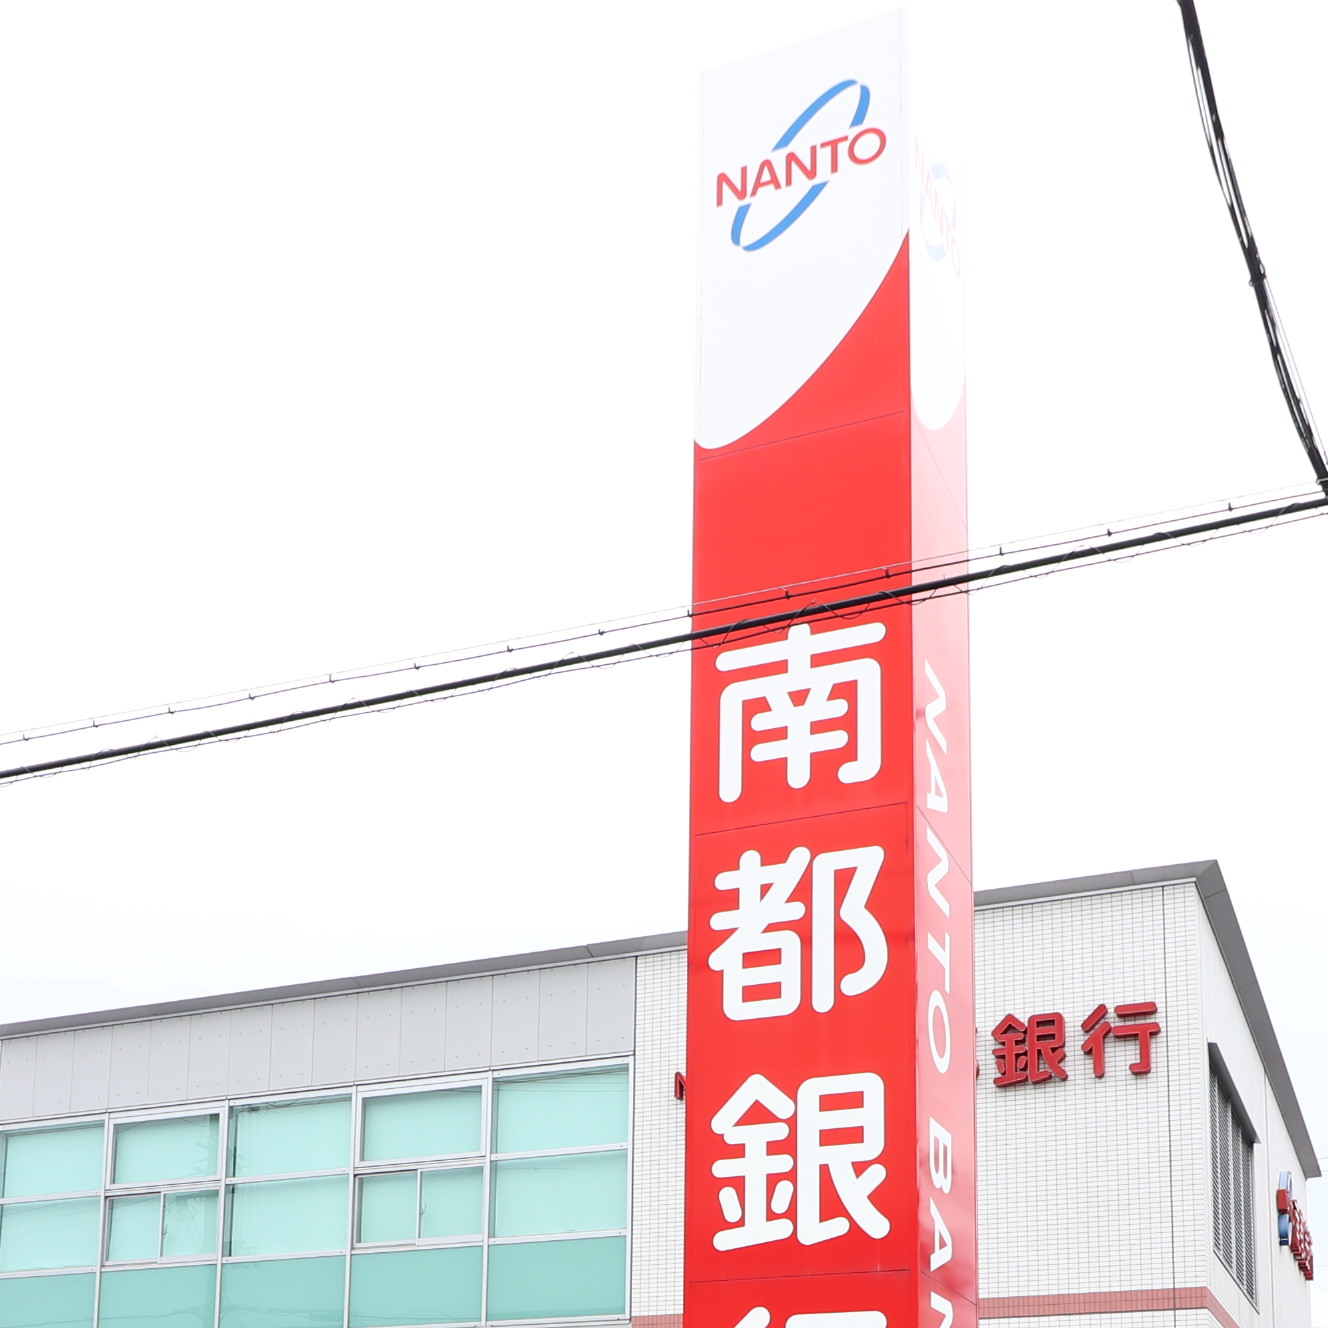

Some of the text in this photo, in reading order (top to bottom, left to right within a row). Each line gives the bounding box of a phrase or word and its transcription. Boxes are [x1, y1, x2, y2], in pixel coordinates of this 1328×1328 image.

[715, 126, 887, 208] NANTO
[914, 133, 962, 279] NANTO
[924, 659, 952, 1076] NANTO
[977, 1001, 1161, 1088] 銀行
